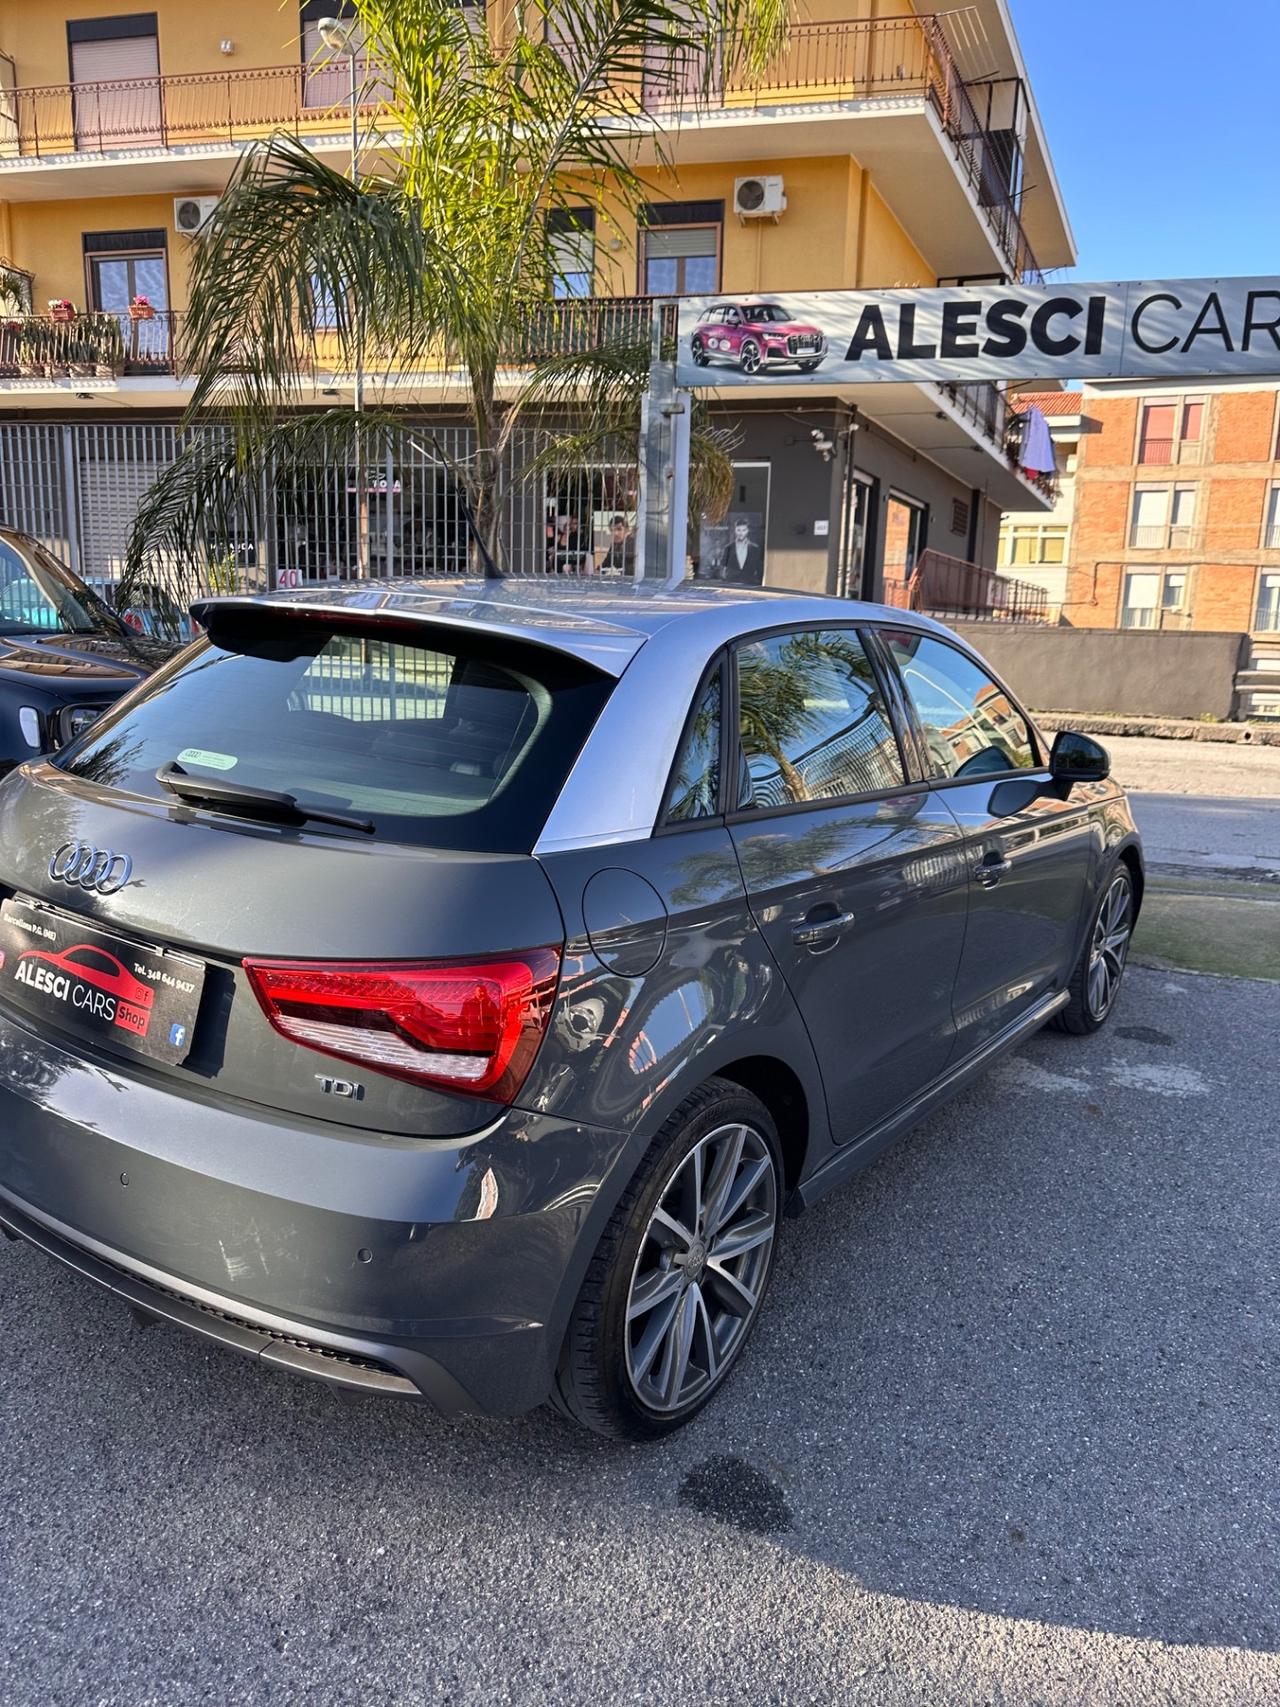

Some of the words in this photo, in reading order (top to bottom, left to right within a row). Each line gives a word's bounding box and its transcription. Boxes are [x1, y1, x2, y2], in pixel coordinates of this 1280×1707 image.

[844, 295, 1107, 361] ALESCI
[14, 960, 70, 1001] ALESCI
[72, 984, 116, 1021] CARS
[118, 1005, 145, 1030] Shop
[147, 969, 161, 981] 348
[161, 972, 176, 987] 644
[176, 979, 195, 993] 9437
[314, 1073, 365, 1101] TDI
